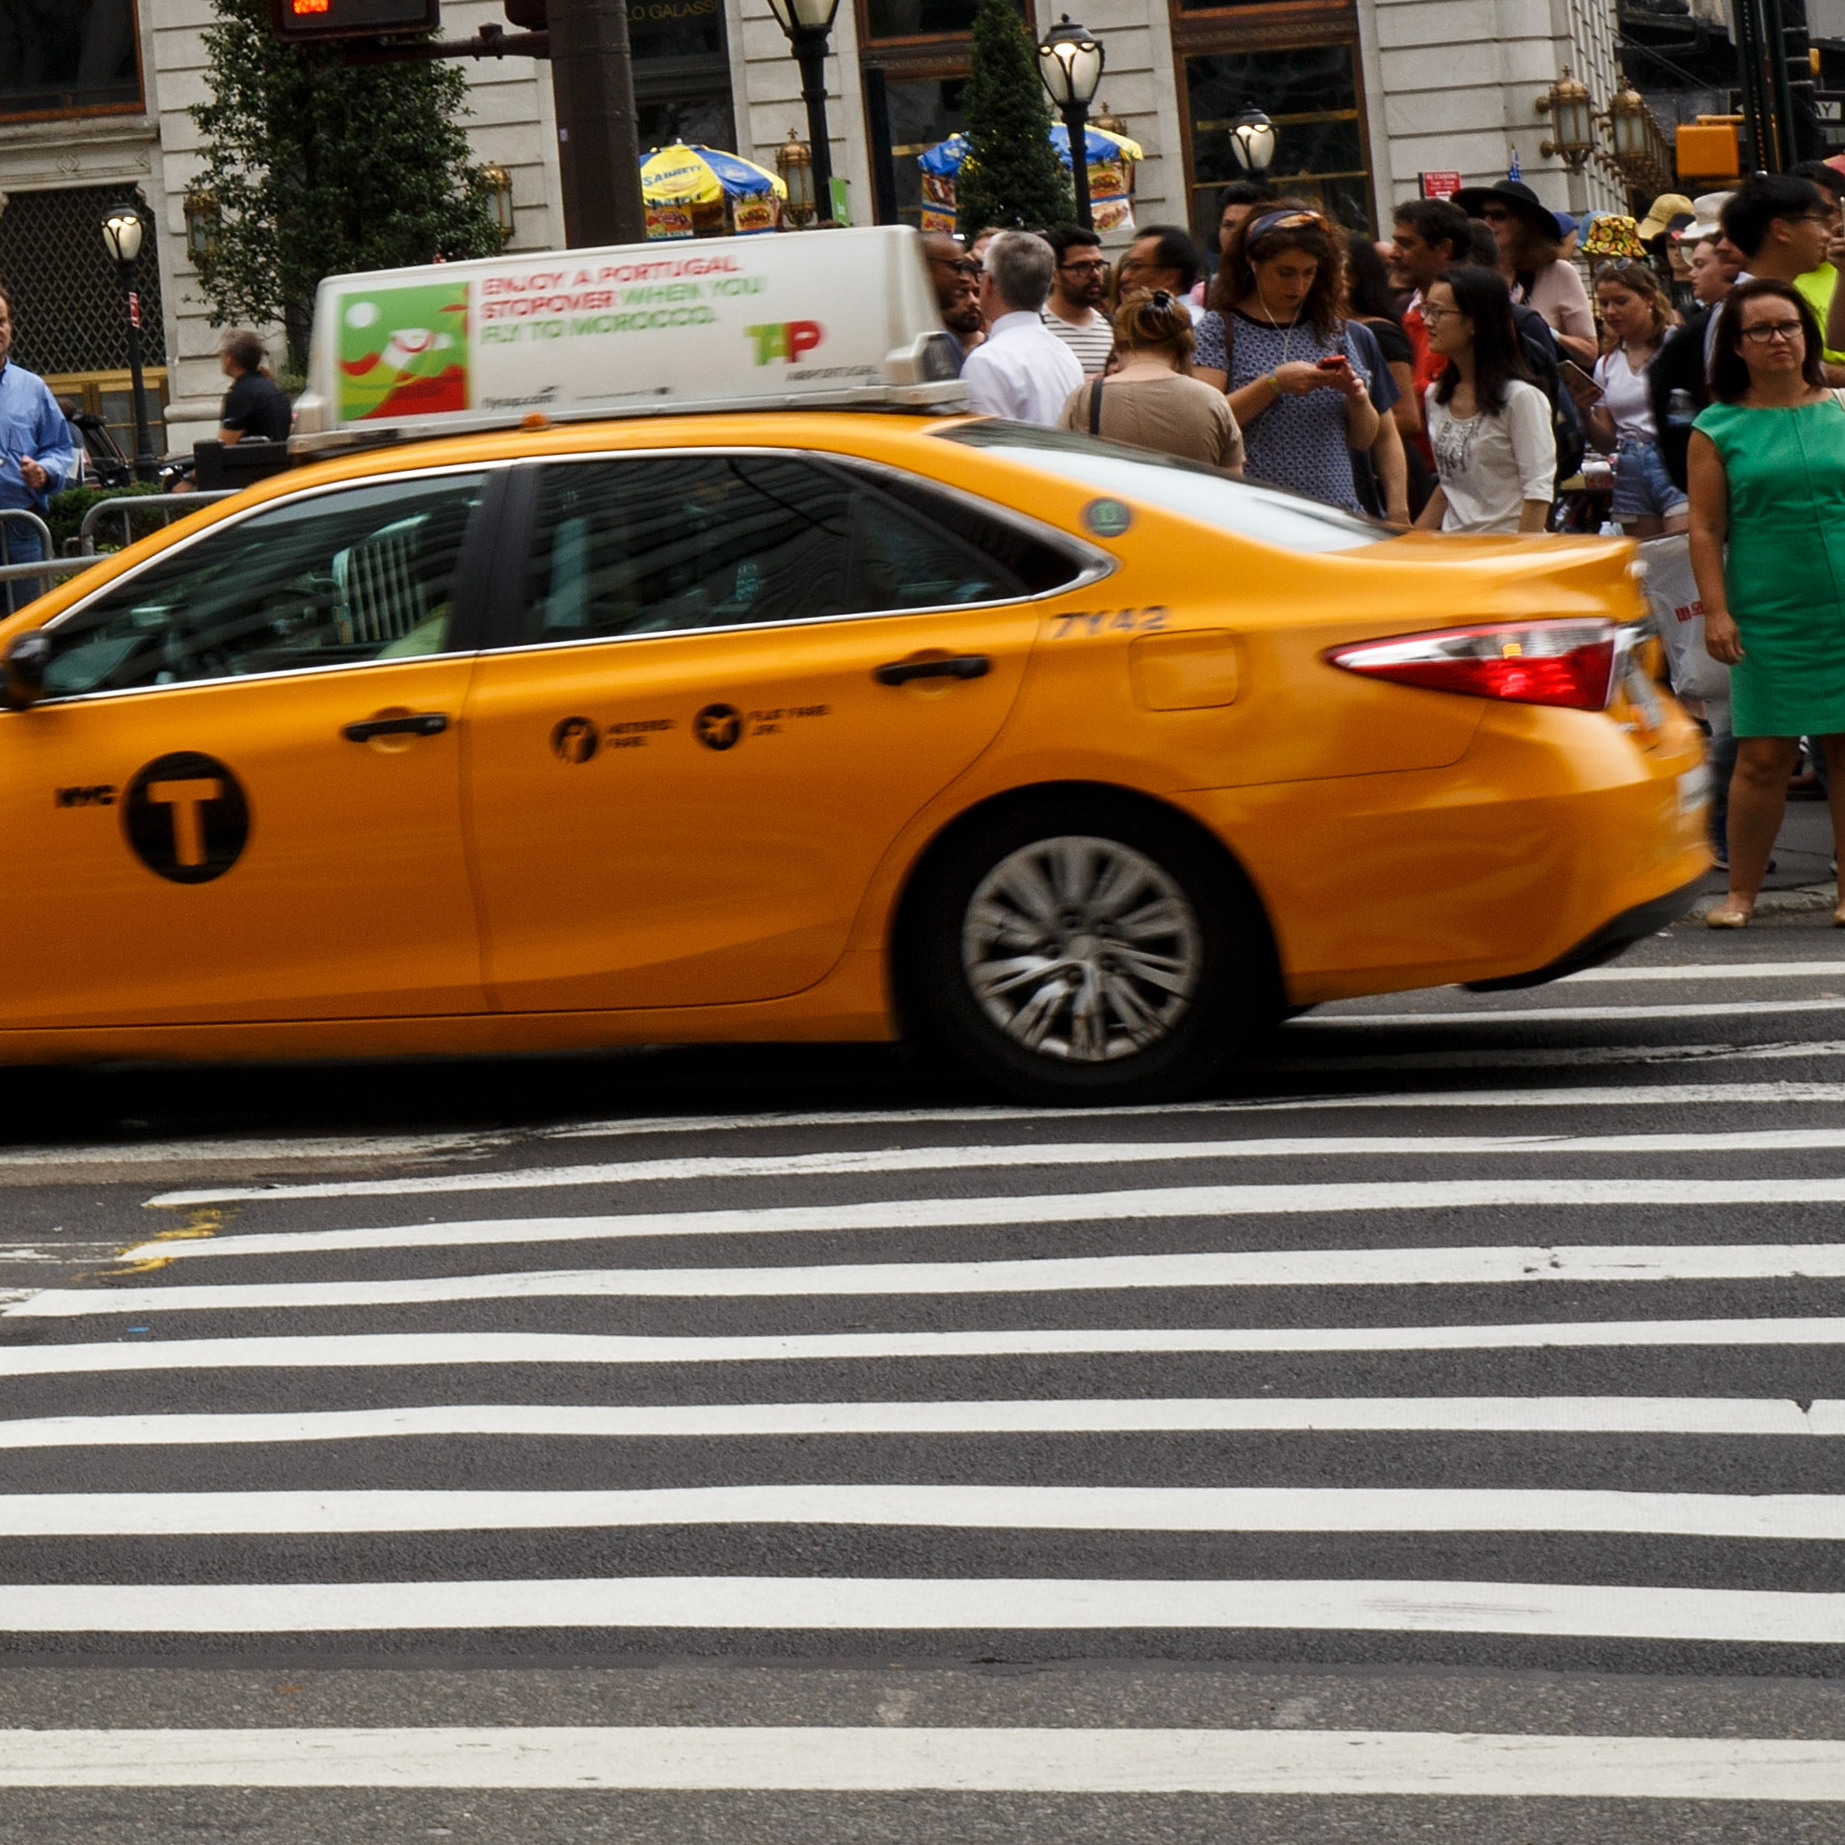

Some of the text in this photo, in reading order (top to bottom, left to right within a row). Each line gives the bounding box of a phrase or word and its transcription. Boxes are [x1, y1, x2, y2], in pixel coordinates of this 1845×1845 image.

[650, 0, 717, 19] GALASS
[482, 255, 743, 296] ENJOY A PORTUGAL
[481, 275, 766, 320] STOPOVER WHEN YOU
[481, 324, 521, 344] FLY
[529, 319, 565, 339] TO
[745, 319, 825, 366] TAP
[55, 777, 224, 867] NYC T
